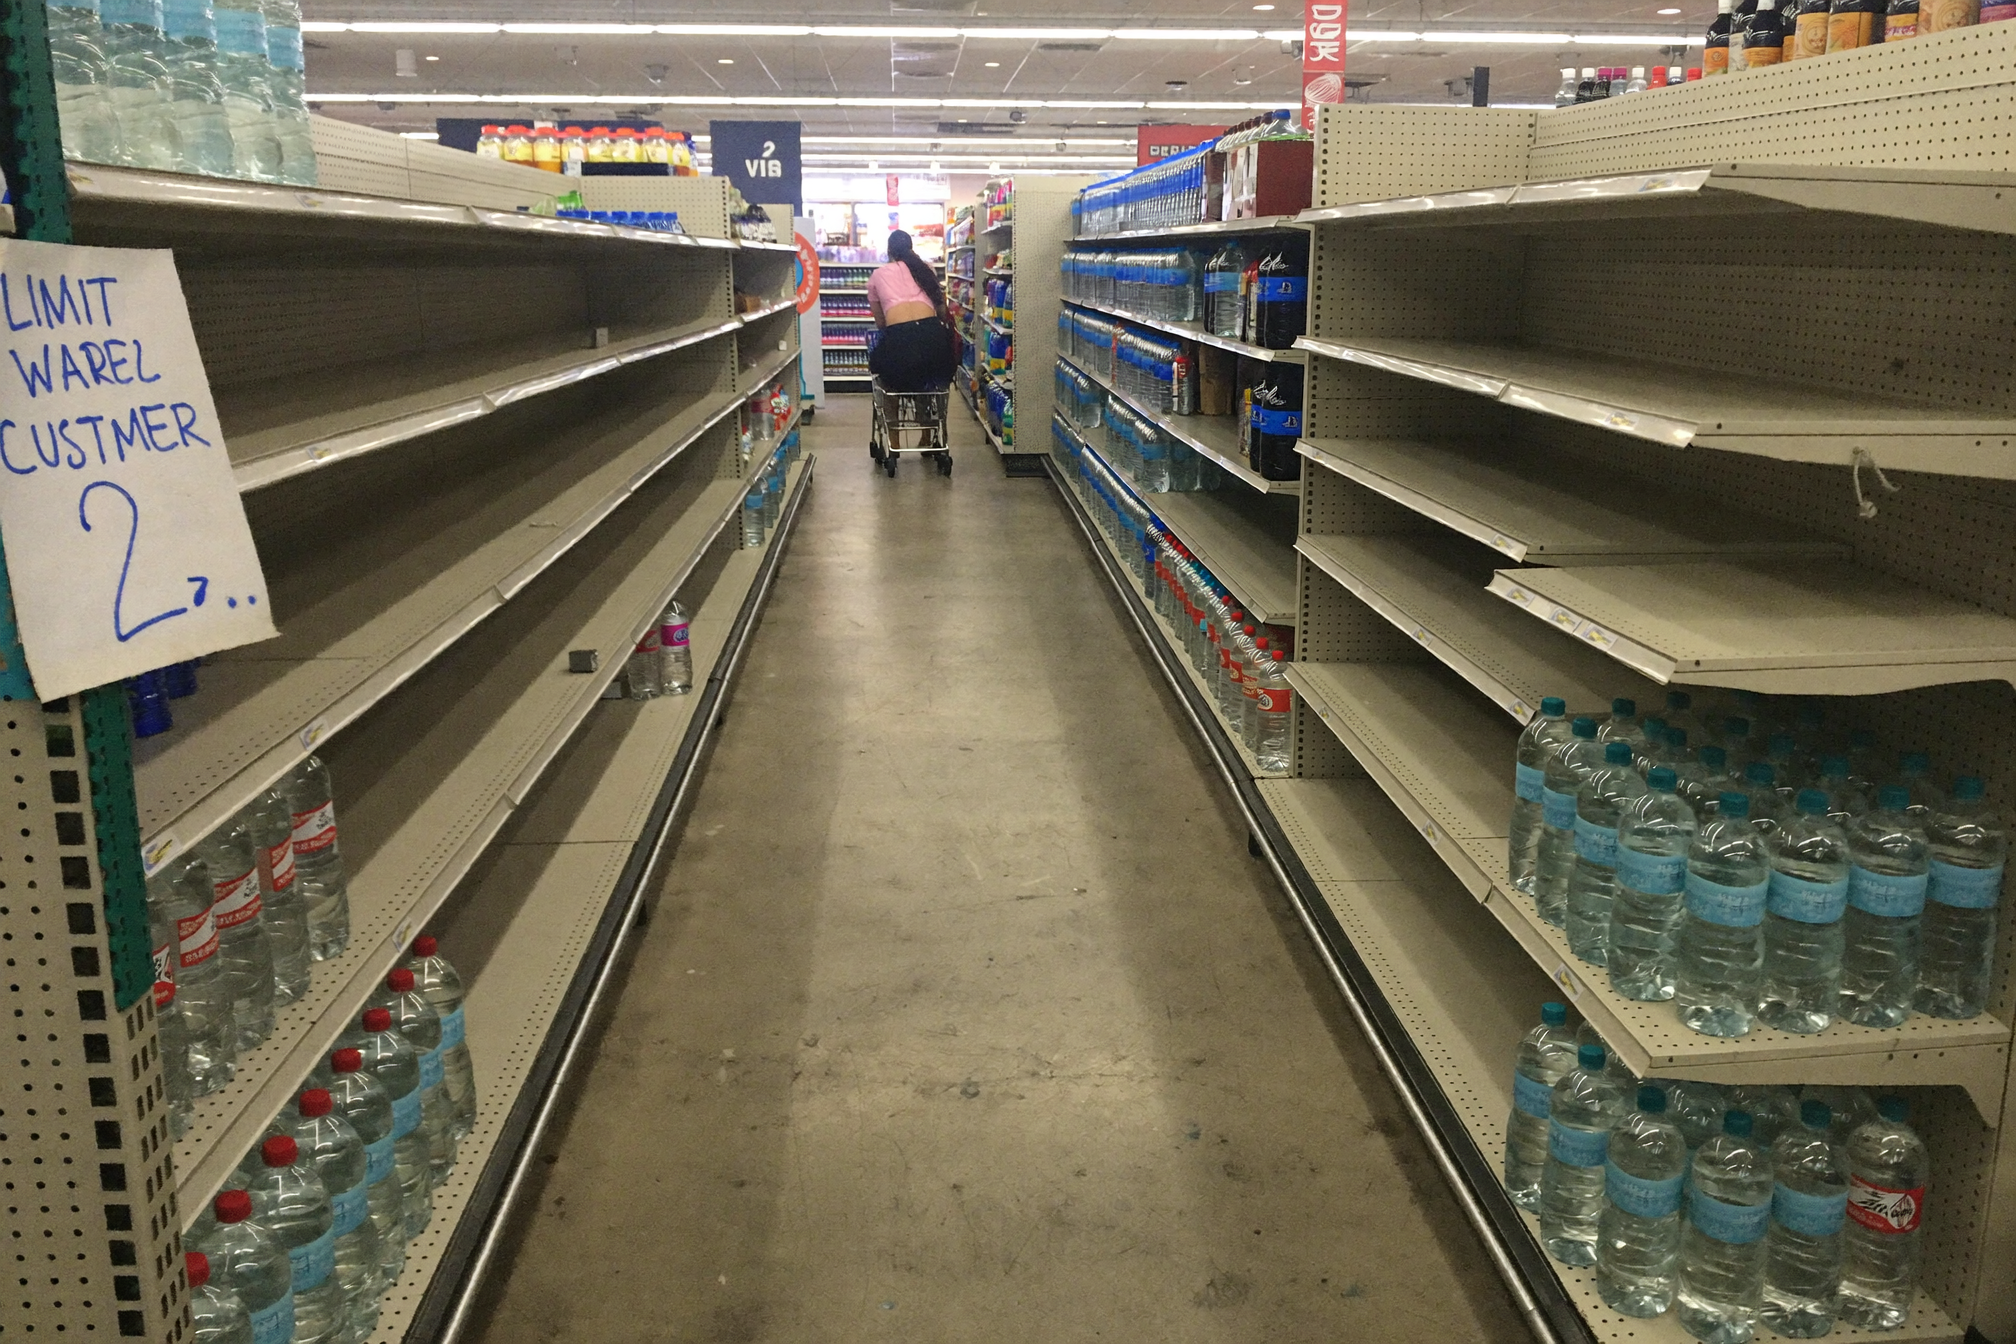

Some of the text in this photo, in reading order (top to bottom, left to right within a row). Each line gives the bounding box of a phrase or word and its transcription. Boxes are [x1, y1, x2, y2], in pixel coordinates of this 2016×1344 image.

[762, 140, 776, 158] 2
[1, 272, 118, 331] LIMIT
[0, 402, 211, 475] CUSTMER
